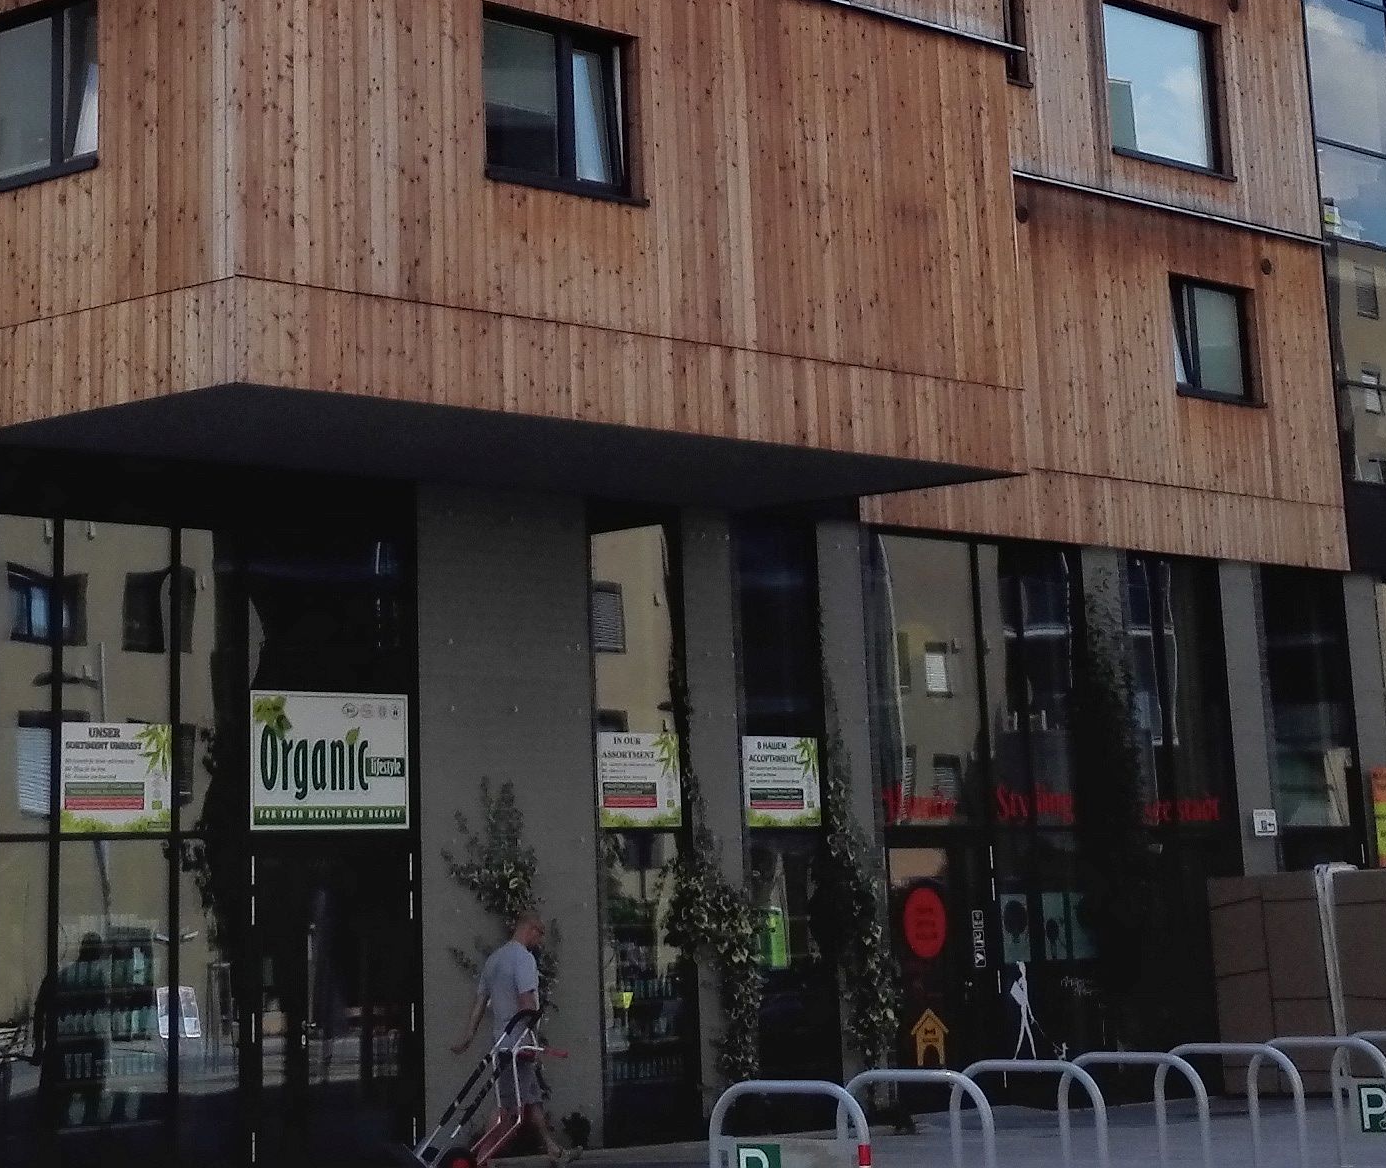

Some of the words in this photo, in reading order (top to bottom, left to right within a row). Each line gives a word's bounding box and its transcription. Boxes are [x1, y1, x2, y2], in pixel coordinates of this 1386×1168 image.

[261, 725, 368, 800] Organic
[259, 809, 276, 819] FOR
[280, 809, 303, 819] YOUR
[308, 809, 342, 819] HEALTH
[346, 809, 363, 819] AND
[368, 809, 401, 819] BEAUTY
